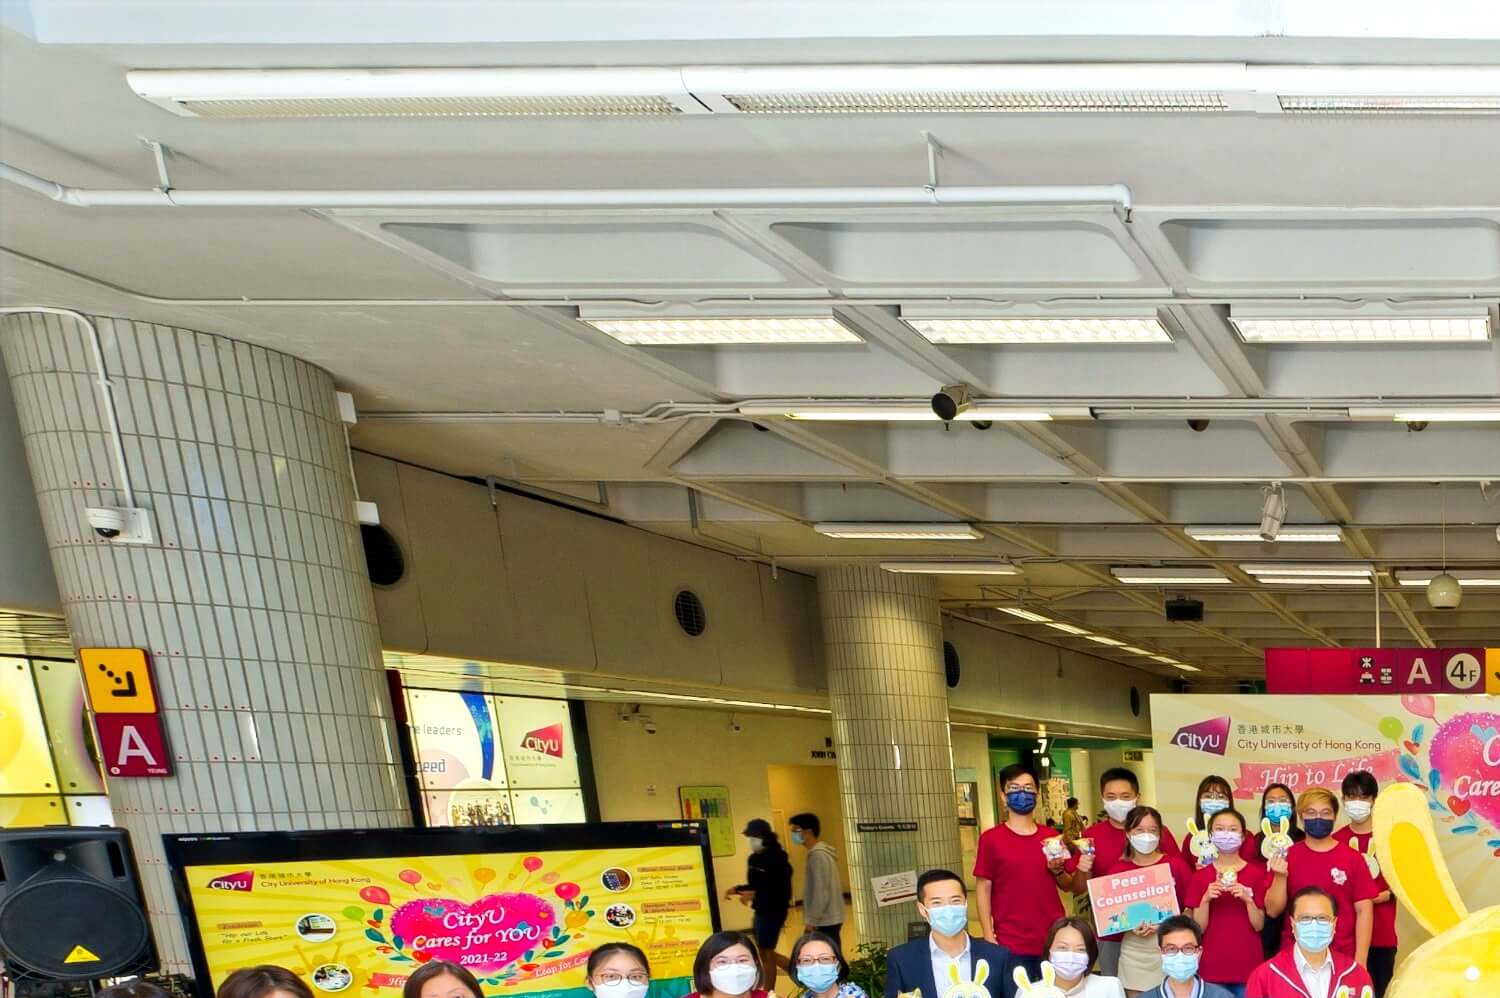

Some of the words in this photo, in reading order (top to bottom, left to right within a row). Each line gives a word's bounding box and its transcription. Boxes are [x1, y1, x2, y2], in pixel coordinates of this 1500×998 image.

[1408, 658, 1432, 684] A
[1451, 660, 1477, 682] 4F
[424, 723, 463, 736] leaders
[1237, 724, 1304, 735] 香港城市大學
[118, 725, 157, 765] A
[526, 736, 559, 755] CityU
[1177, 732, 1220, 751] CityU
[1238, 740, 1258, 751] City
[1261, 739, 1310, 751] University
[1311, 739, 1324, 750] of
[1325, 740, 1352, 752] Hong
[1355, 740, 1381, 752] Kong
[1260, 768, 1299, 789] Hip
[1306, 769, 1325, 784] to
[211, 880, 247, 891] CityU
[261, 880, 278, 888] City
[280, 878, 317, 887] University
[1111, 874, 1145, 890] Peer
[1096, 884, 1171, 908] Counsellor
[444, 907, 505, 933] CityU
[413, 936, 461, 951] Cares
[465, 931, 492, 950] for
[496, 925, 541, 943] YOU
[461, 952, 508, 964] 2021-22
[535, 965, 558, 977] Leap
[559, 960, 573, 972] for
